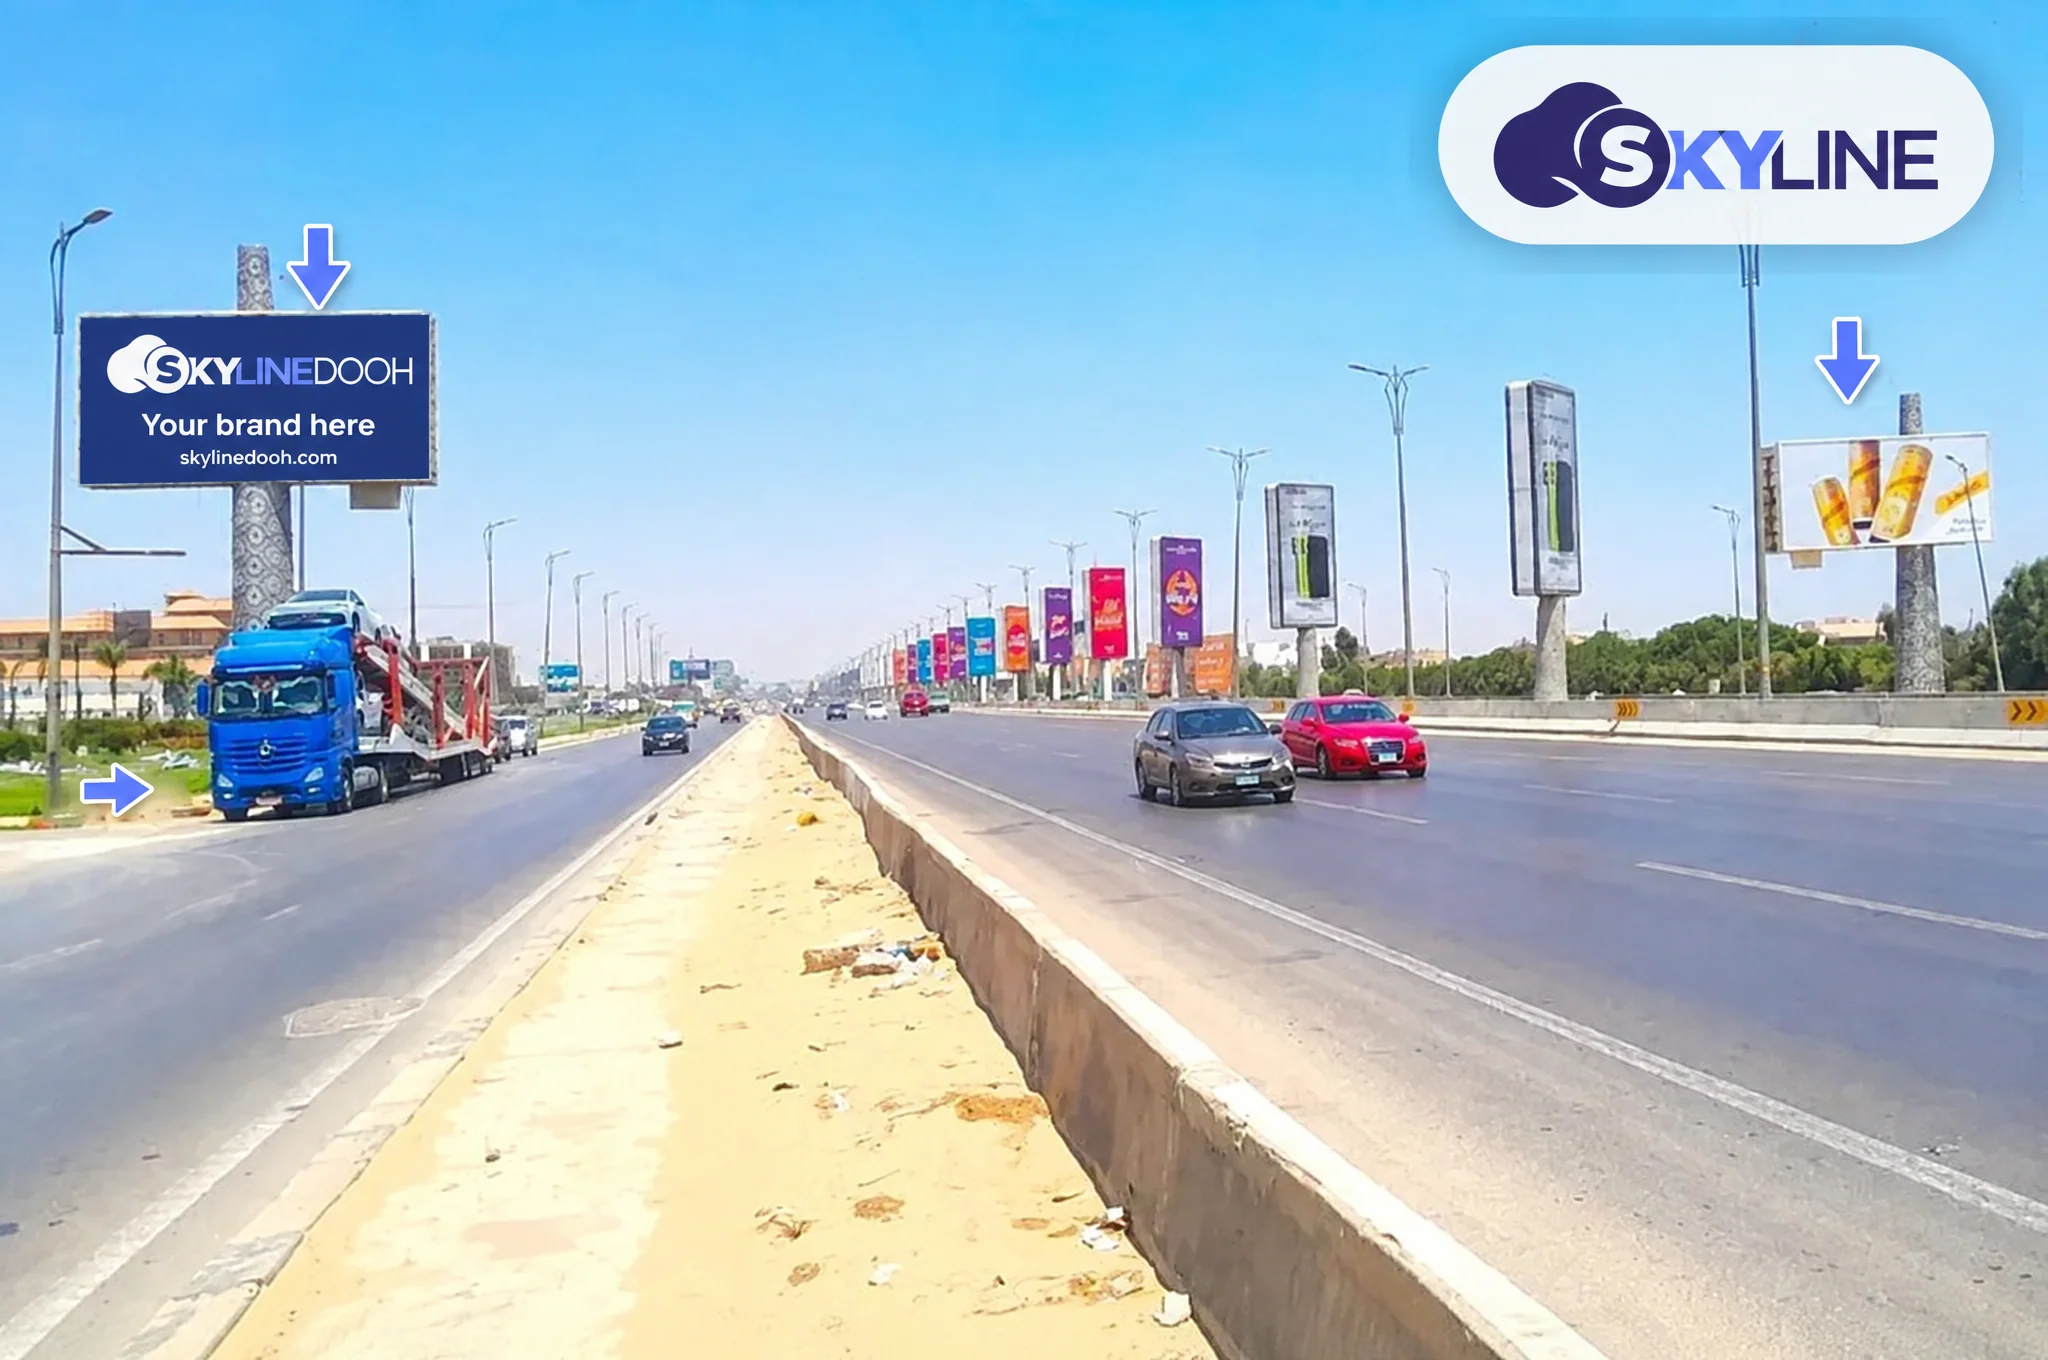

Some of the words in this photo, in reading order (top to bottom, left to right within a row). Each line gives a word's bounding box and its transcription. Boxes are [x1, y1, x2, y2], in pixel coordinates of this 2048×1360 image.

[156, 354, 413, 385] SKYLINEDOOH
[142, 413, 208, 436] Your
[217, 413, 300, 436] brand
[311, 413, 375, 436] here
[180, 450, 337, 468] skylinedooh.com
